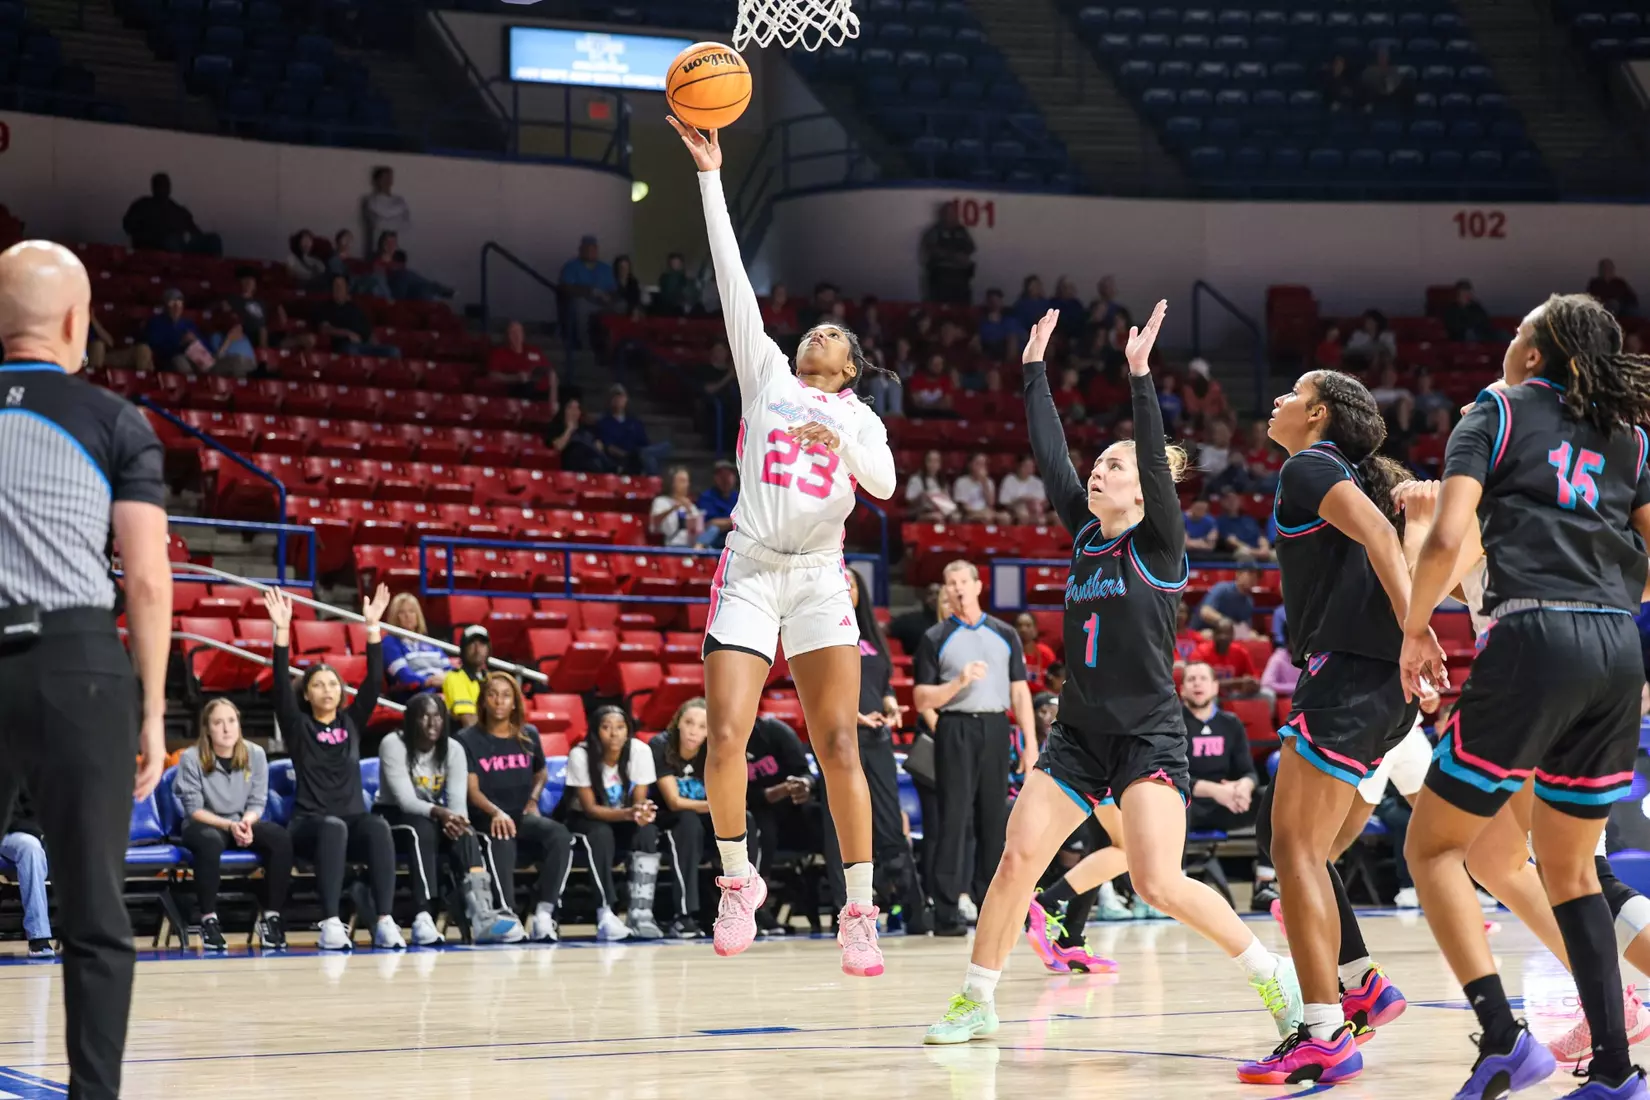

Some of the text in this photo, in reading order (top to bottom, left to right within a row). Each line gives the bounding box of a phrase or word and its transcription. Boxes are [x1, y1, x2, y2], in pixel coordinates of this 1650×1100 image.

[682, 52, 741, 74] Wilson
[1453, 210, 1506, 239] 102
[761, 427, 840, 499] 23
[1548, 440, 1606, 511] 15
[1064, 566, 1128, 610] Panthers
[1083, 612, 1100, 668] 1
